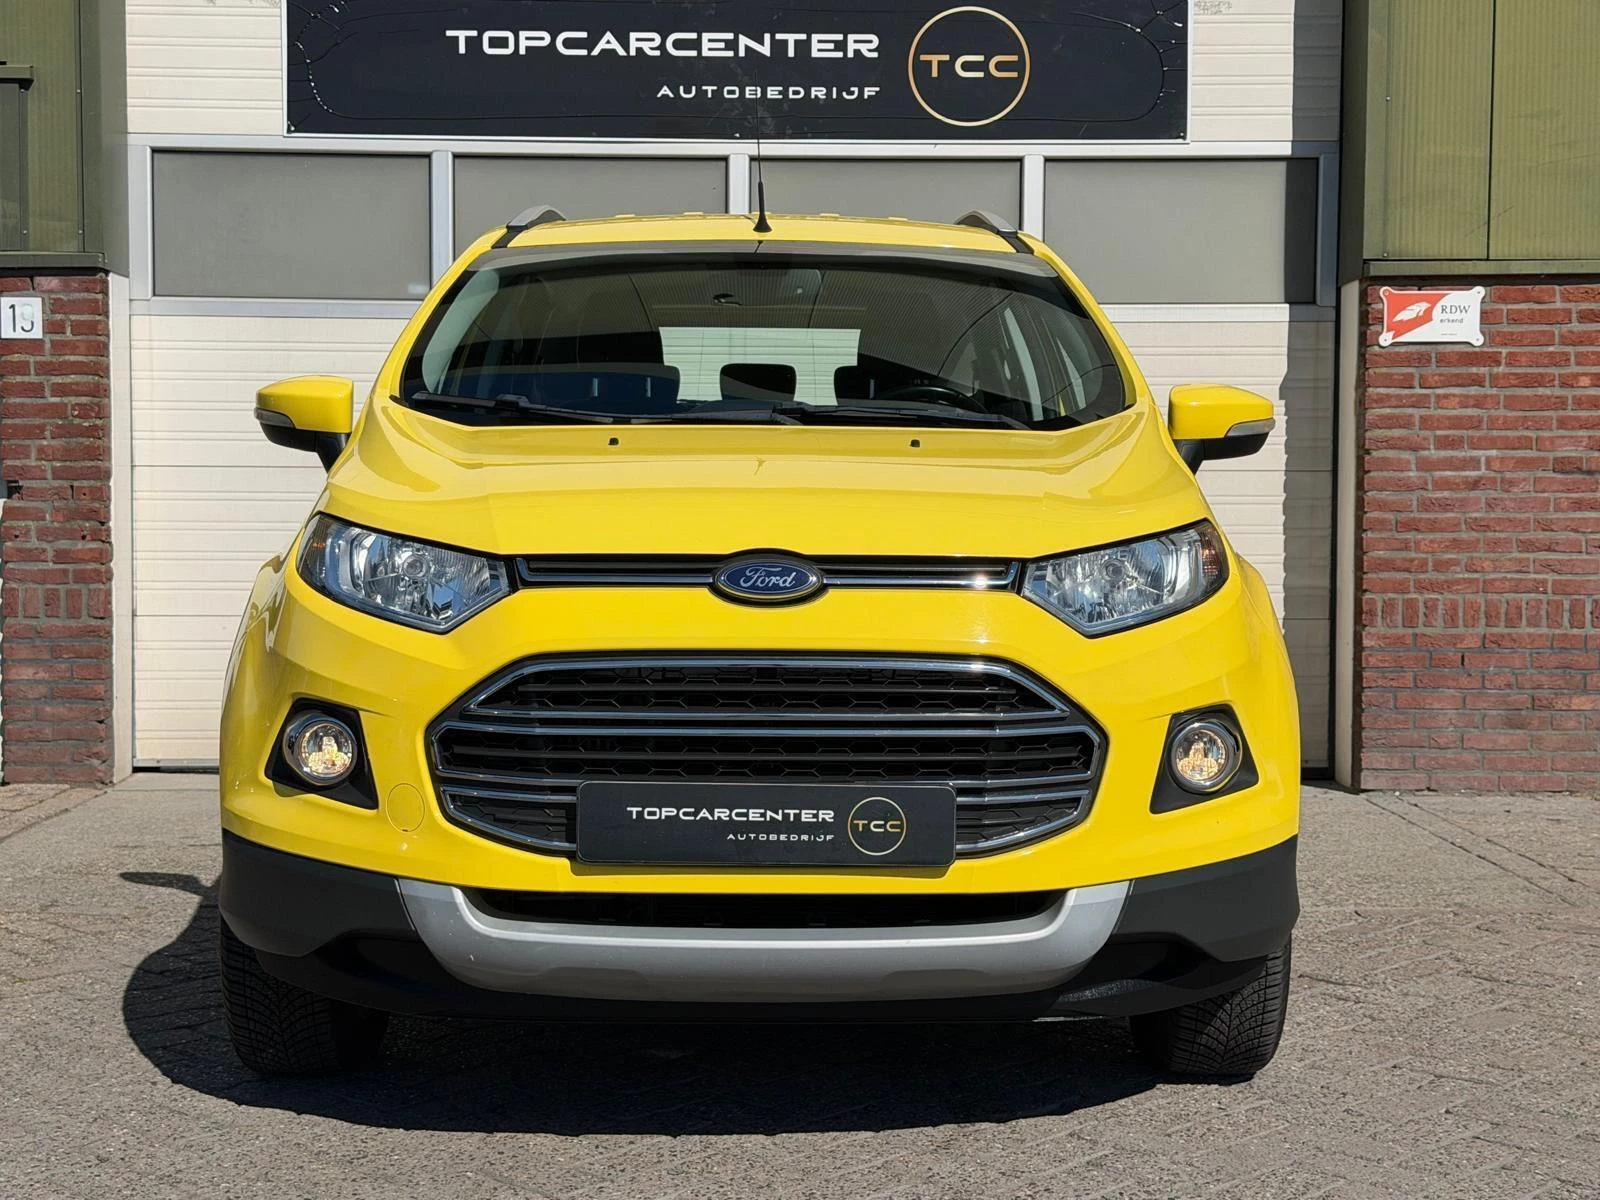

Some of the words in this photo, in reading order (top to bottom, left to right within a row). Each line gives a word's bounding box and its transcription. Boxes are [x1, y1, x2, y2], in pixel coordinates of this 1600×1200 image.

[445, 29, 880, 59] TOPCARCENTER
[919, 54, 1019, 78] TCC
[656, 85, 881, 100] AUTOBEDRIJF
[1440, 304, 1471, 315] RDW
[740, 566, 797, 587] Ford
[626, 806, 835, 823] TOPCARCENTER
[853, 820, 902, 833] TCC
[726, 833, 835, 842] AUTOBEDRIJF
